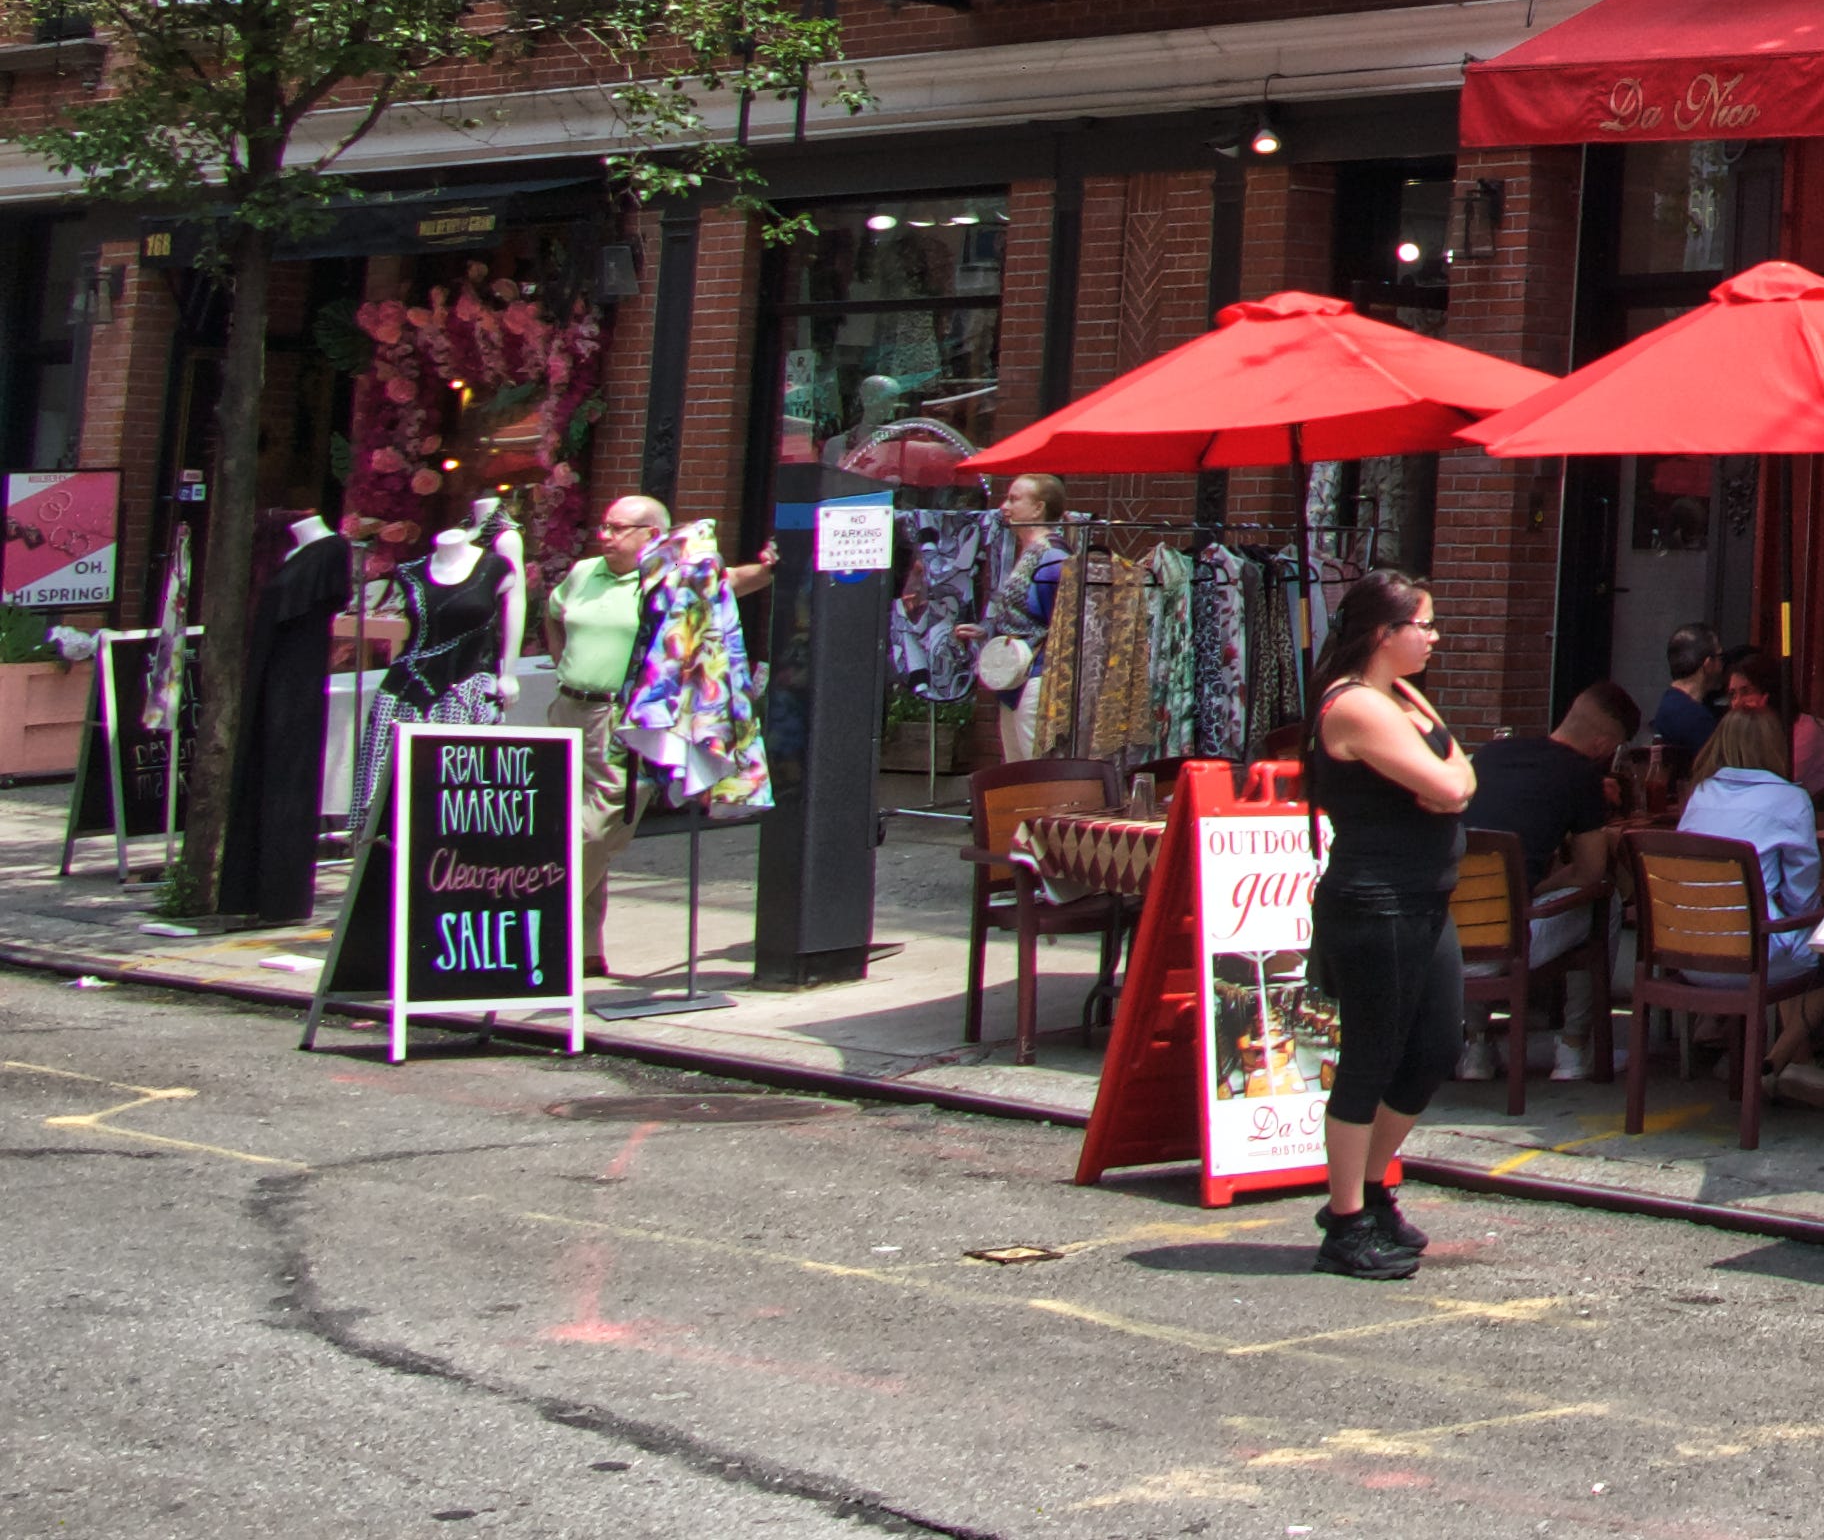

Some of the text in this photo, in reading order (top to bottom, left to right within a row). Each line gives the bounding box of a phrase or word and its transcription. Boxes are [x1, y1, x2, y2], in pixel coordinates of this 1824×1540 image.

[1600, 72, 1762, 132] Da Nico
[833, 528, 882, 538] PARKING
[851, 515, 866, 524] NO
[37, 586, 111, 604] SPRING!
[440, 745, 535, 787] REAL NYC
[440, 788, 539, 836] MARKET
[429, 847, 544, 898] Clearance
[1247, 1106, 1292, 1143] Da
[1271, 1140, 1326, 1156] RISTORA
